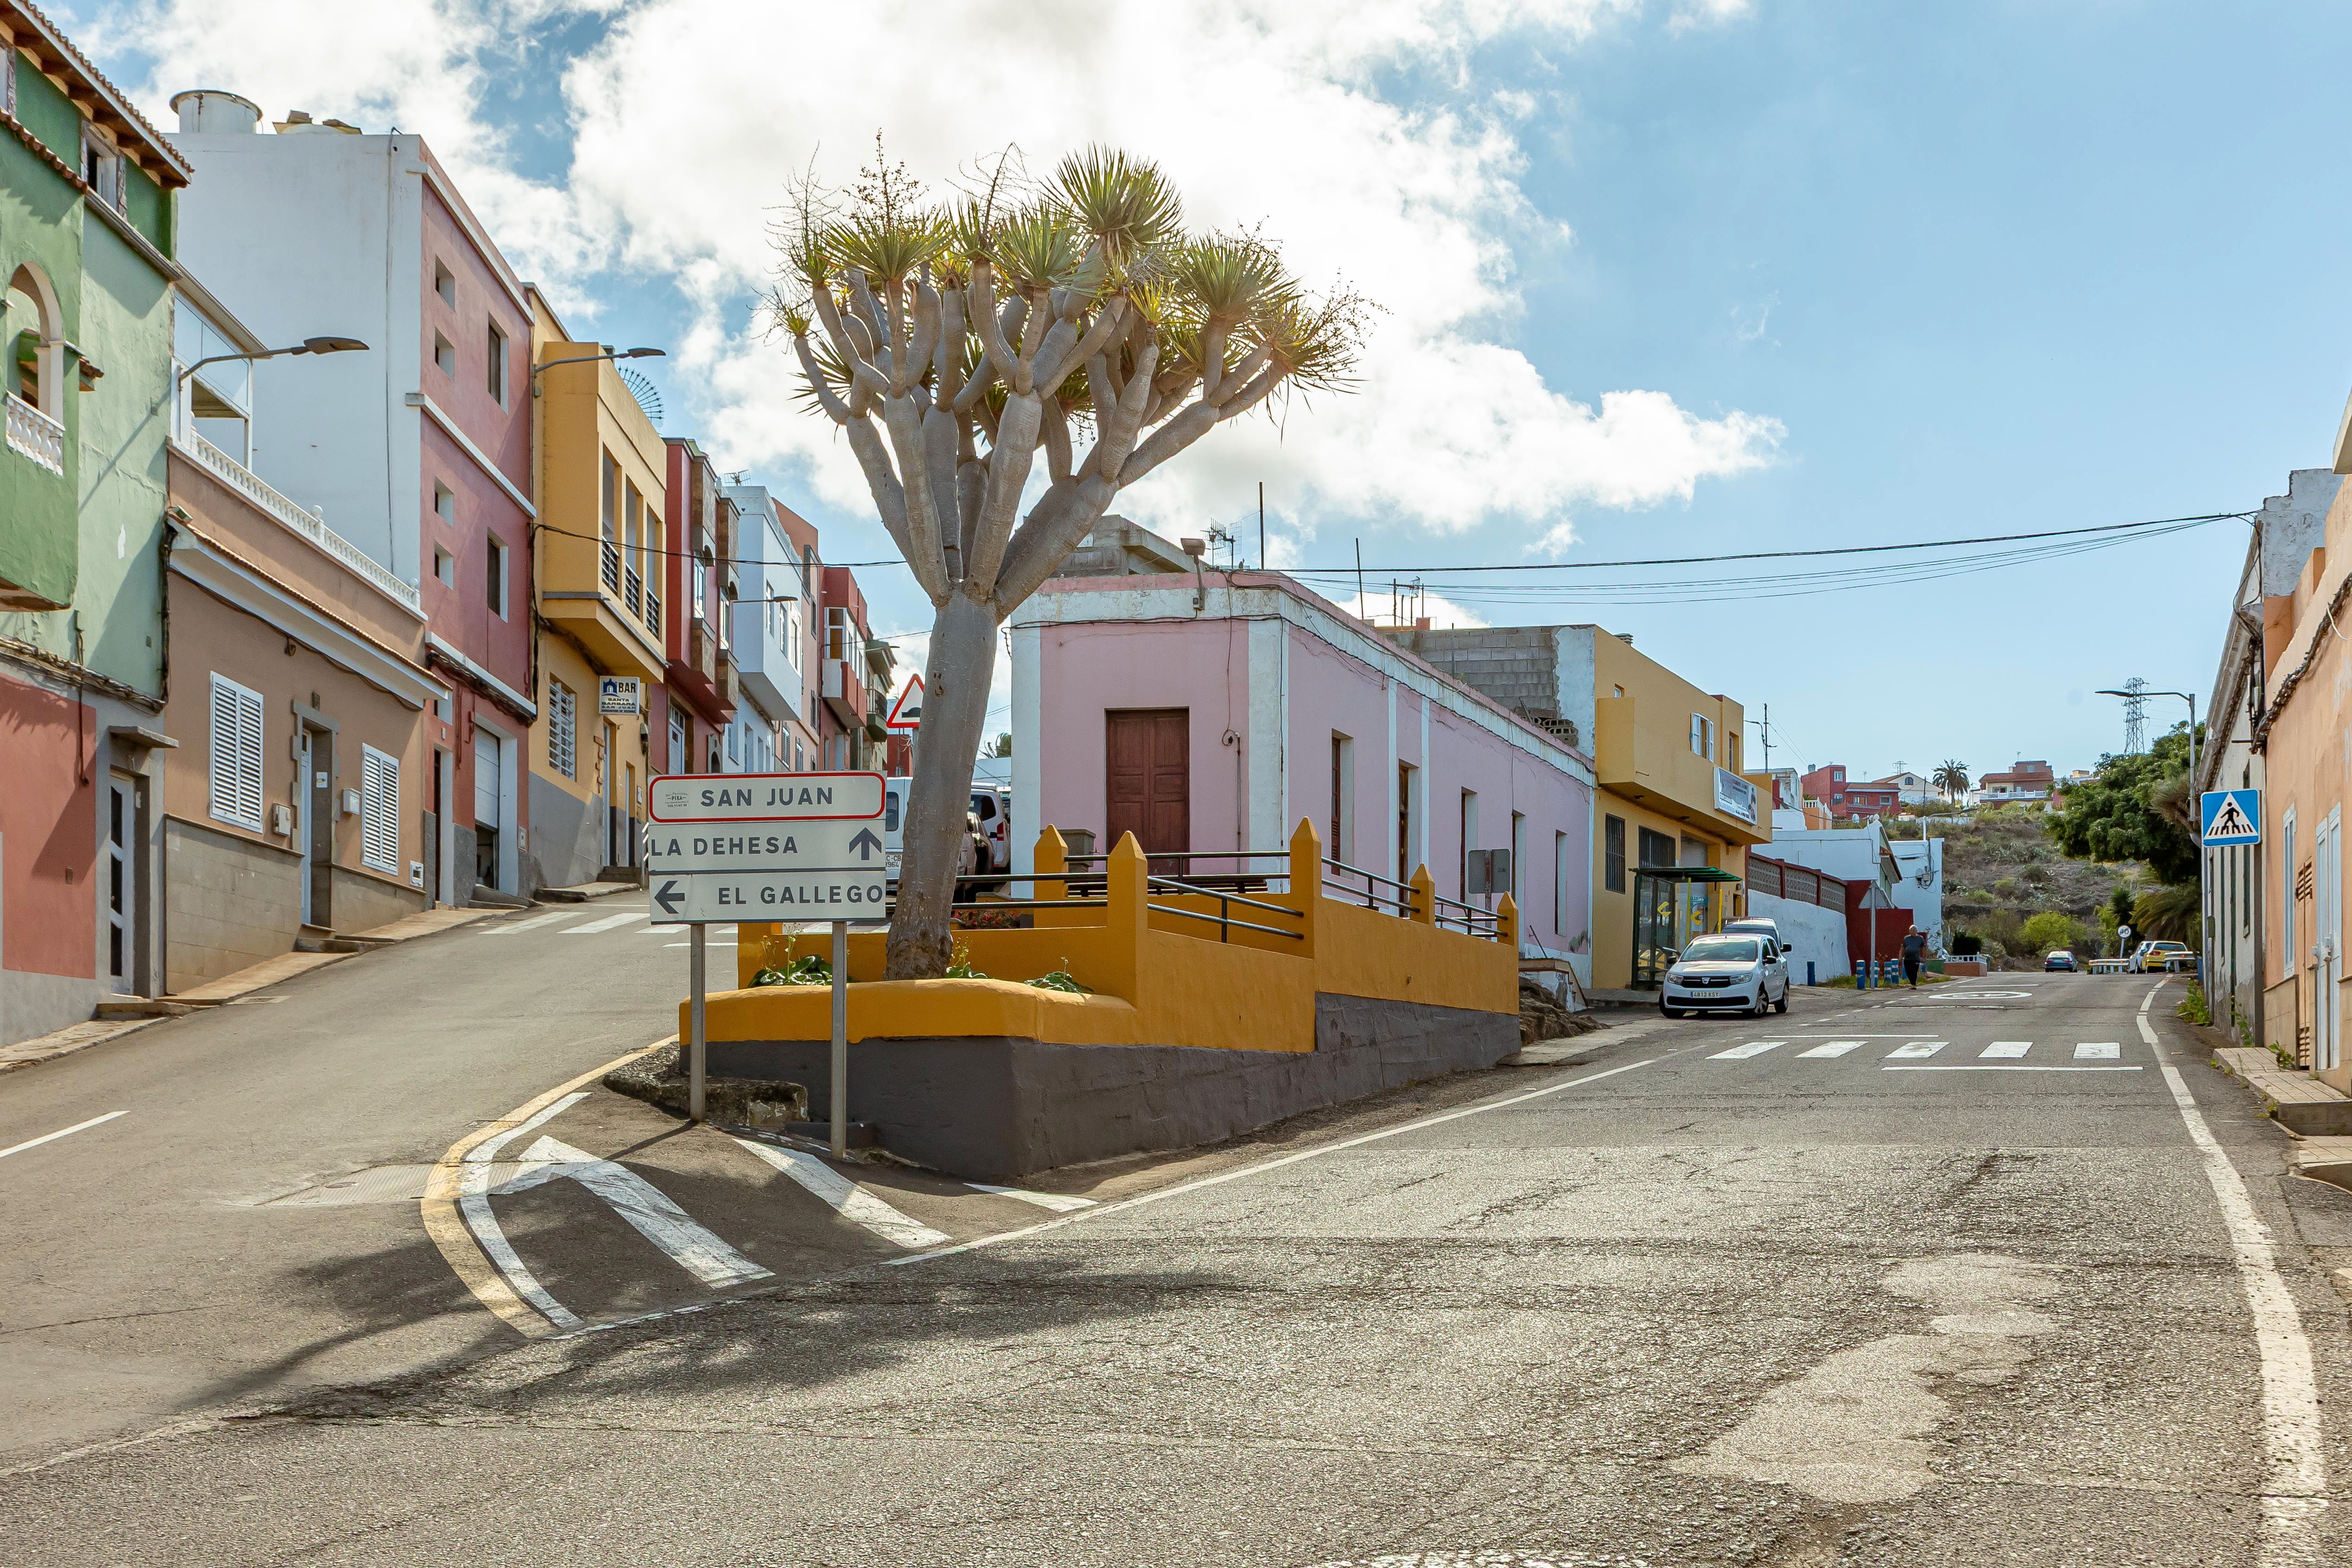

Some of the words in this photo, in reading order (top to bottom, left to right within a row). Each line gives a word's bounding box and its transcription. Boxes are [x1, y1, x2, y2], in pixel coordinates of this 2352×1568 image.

[619, 682, 636, 693] BAR
[700, 789, 752, 807] SAN
[767, 787, 832, 806] JUAN
[651, 839, 682, 856] LA
[694, 836, 798, 855] DEHESA
[718, 887, 747, 904] EL
[760, 885, 883, 904] GALLEGO
